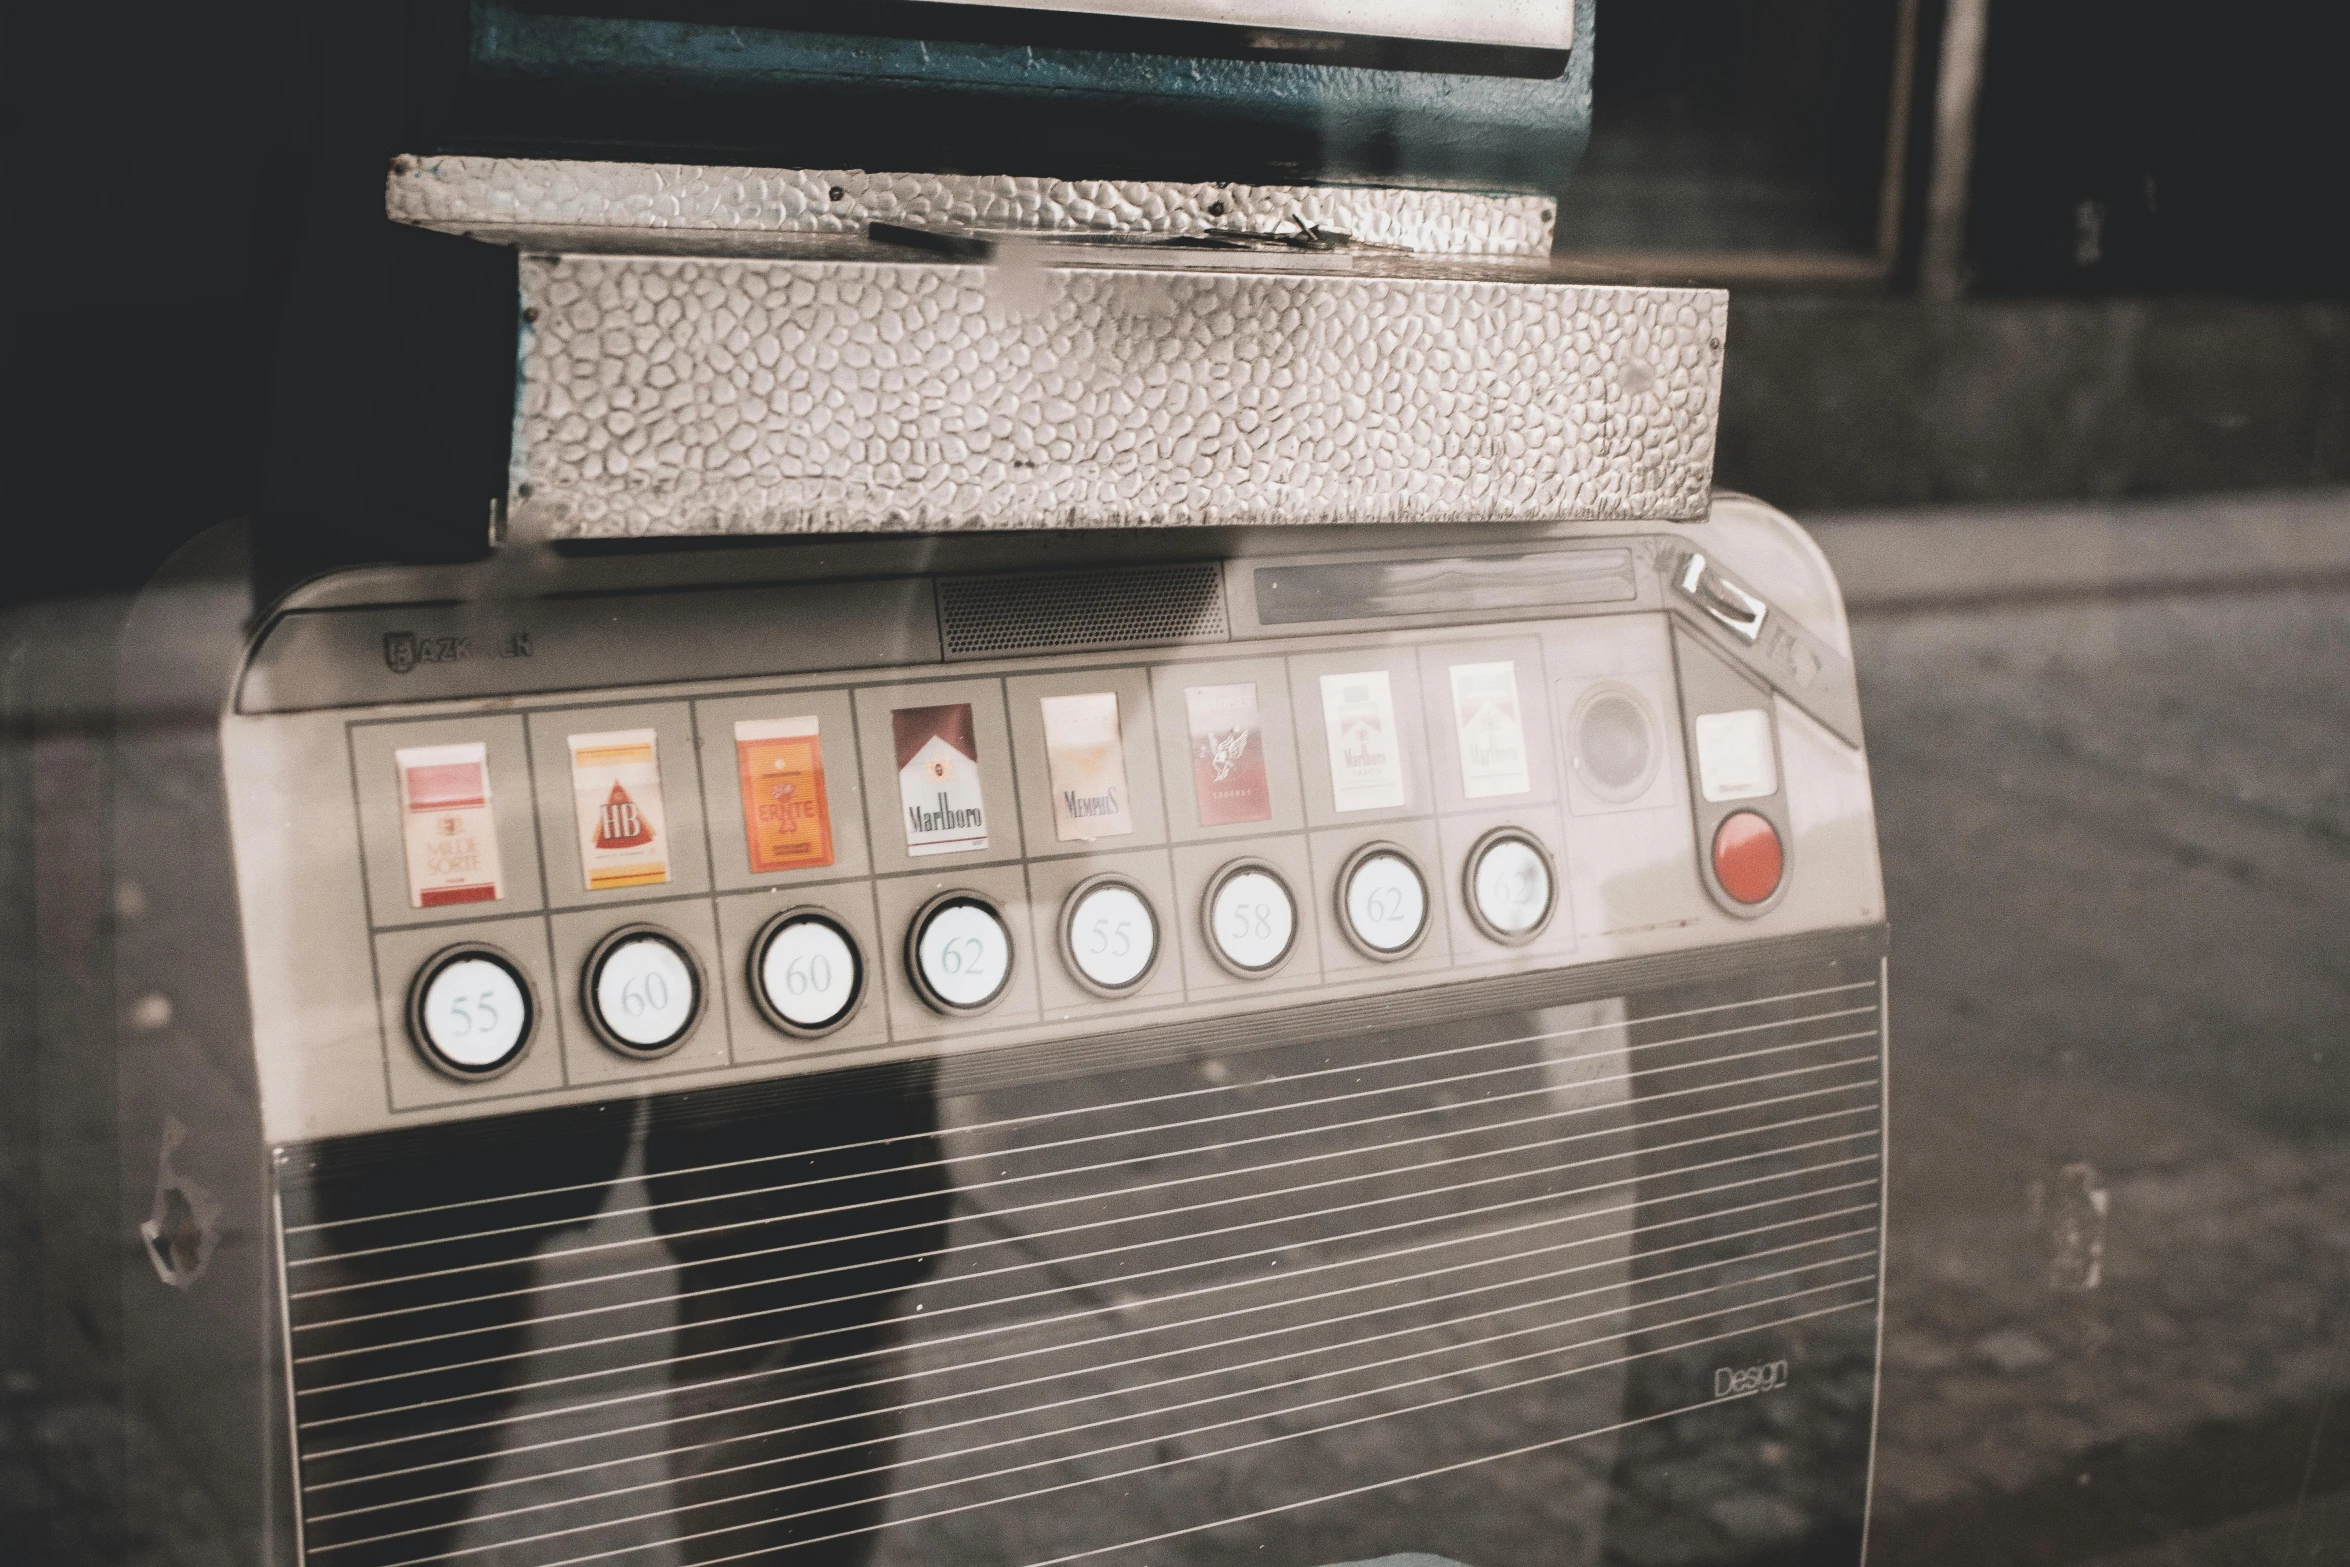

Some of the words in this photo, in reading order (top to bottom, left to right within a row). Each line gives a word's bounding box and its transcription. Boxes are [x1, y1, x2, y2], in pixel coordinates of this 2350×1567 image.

[600, 802, 641, 840] HB
[758, 800, 815, 822] ERNTE
[909, 792, 983, 834] Marlboro
[1366, 886, 1404, 924] 62
[1493, 871, 1531, 905] 62
[1090, 917, 1131, 957] 55
[1231, 902, 1272, 940] 58
[785, 953, 832, 996] 60
[941, 935, 984, 976] 62
[620, 971, 669, 1017] 60
[449, 990, 499, 1038] 55
[1714, 1359, 1788, 1397] Design
